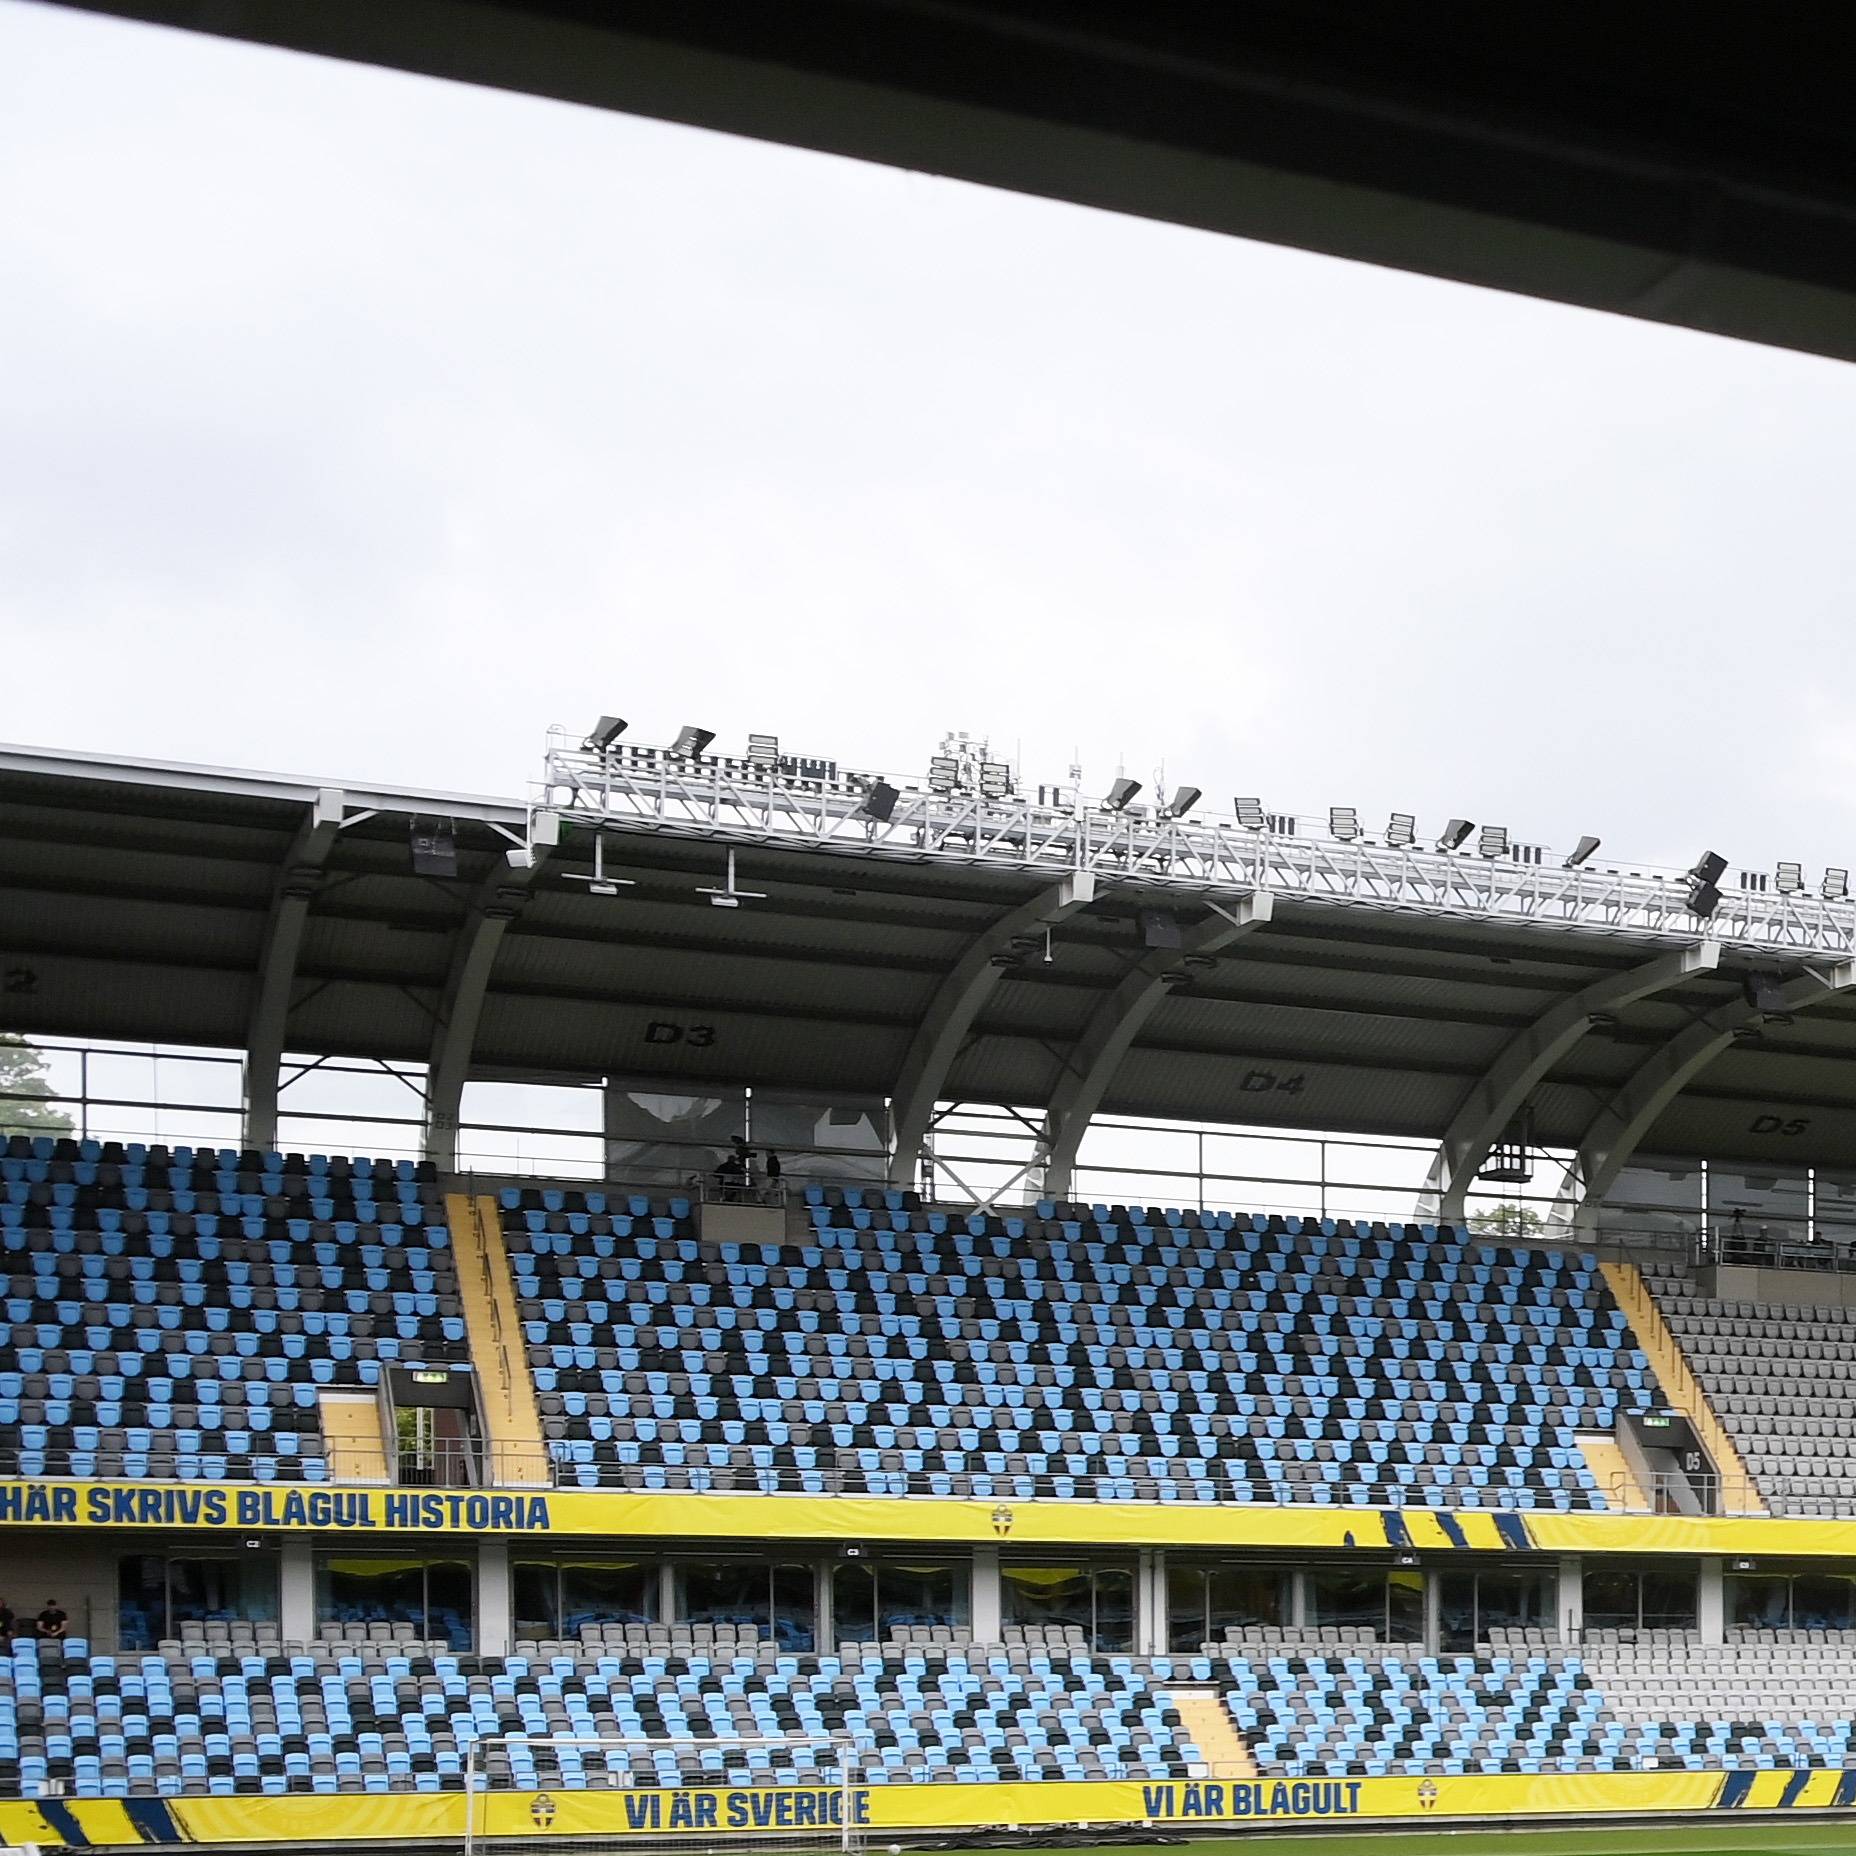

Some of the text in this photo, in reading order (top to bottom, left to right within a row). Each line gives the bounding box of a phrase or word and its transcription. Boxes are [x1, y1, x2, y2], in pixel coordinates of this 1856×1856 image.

[645, 1022, 715, 1046] D3
[0, 1484, 551, 1530] HÄR SKRIVS BLÅGUL HISTORIA
[625, 1791, 870, 1829] VI ÄR SVERIGE
[1143, 1781, 1362, 1818] VI ÄR BLÅGULT
